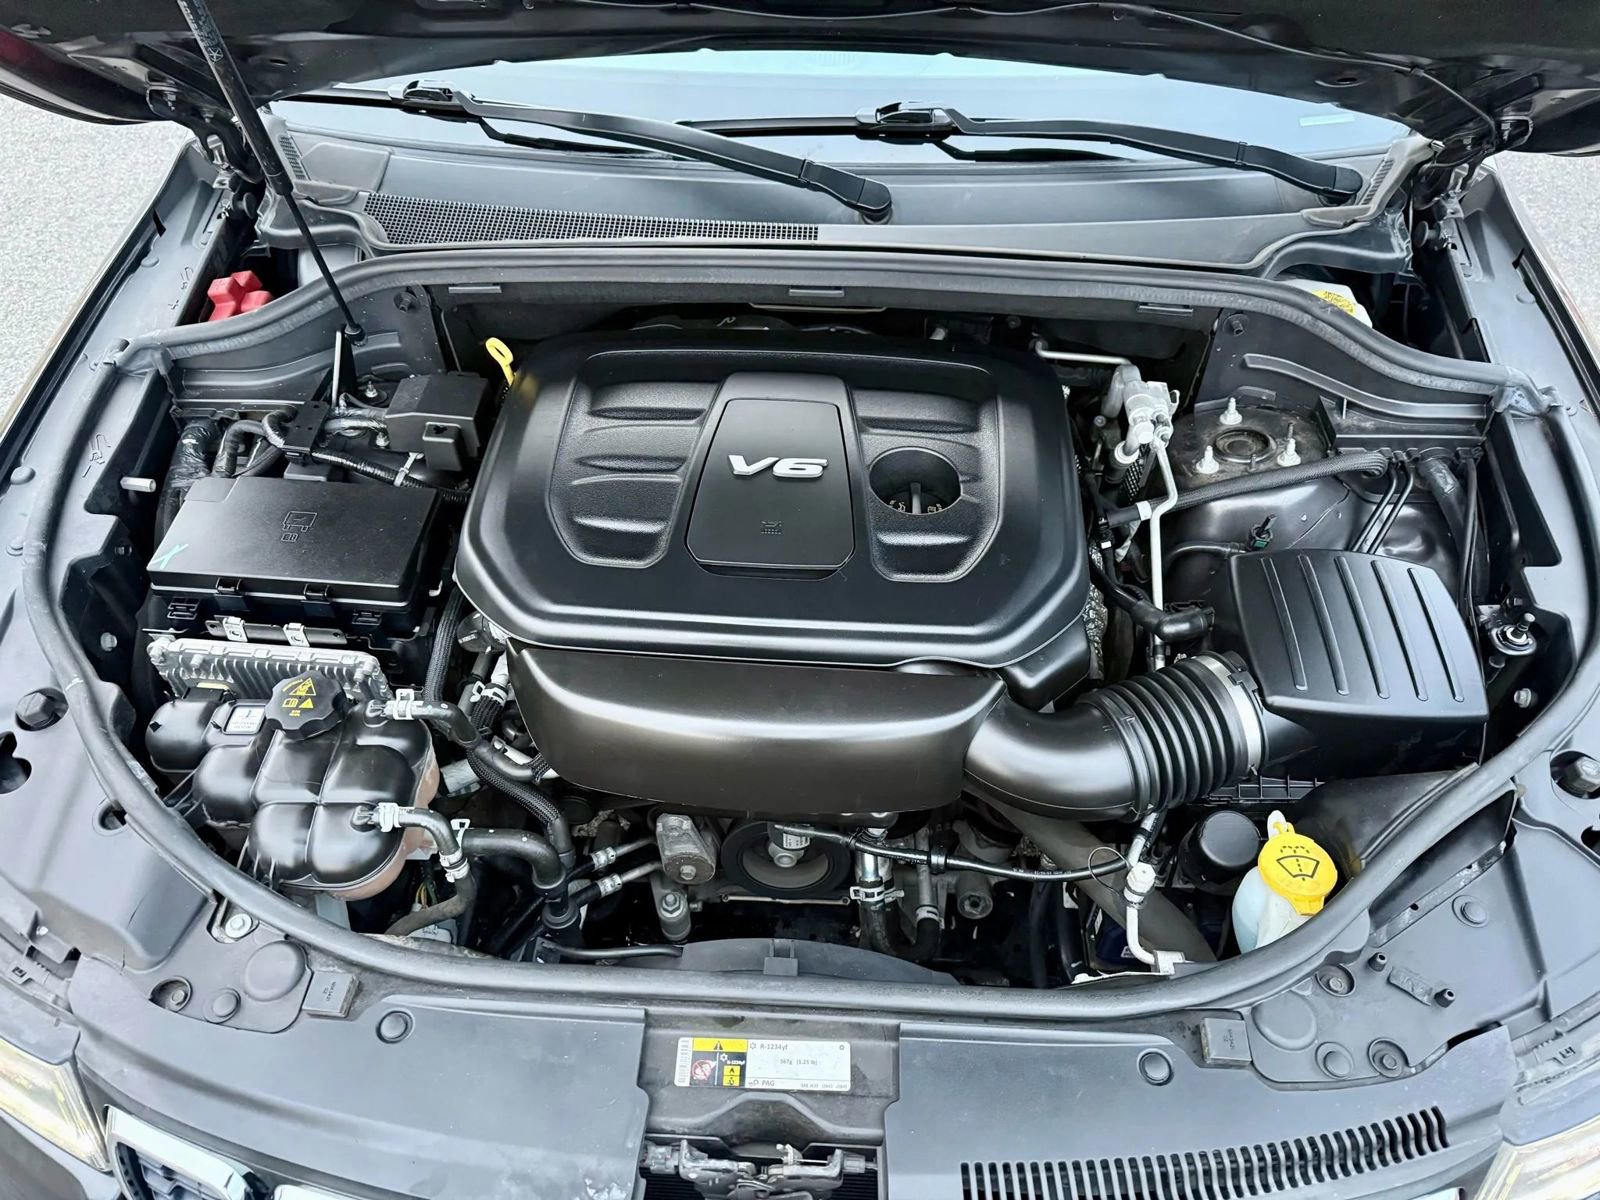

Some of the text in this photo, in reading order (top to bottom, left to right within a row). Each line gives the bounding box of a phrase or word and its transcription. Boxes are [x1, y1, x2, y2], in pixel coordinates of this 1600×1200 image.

[728, 454, 828, 479] V6
[760, 1043, 788, 1052] R-1234yf
[761, 1079, 775, 1087] PAG
